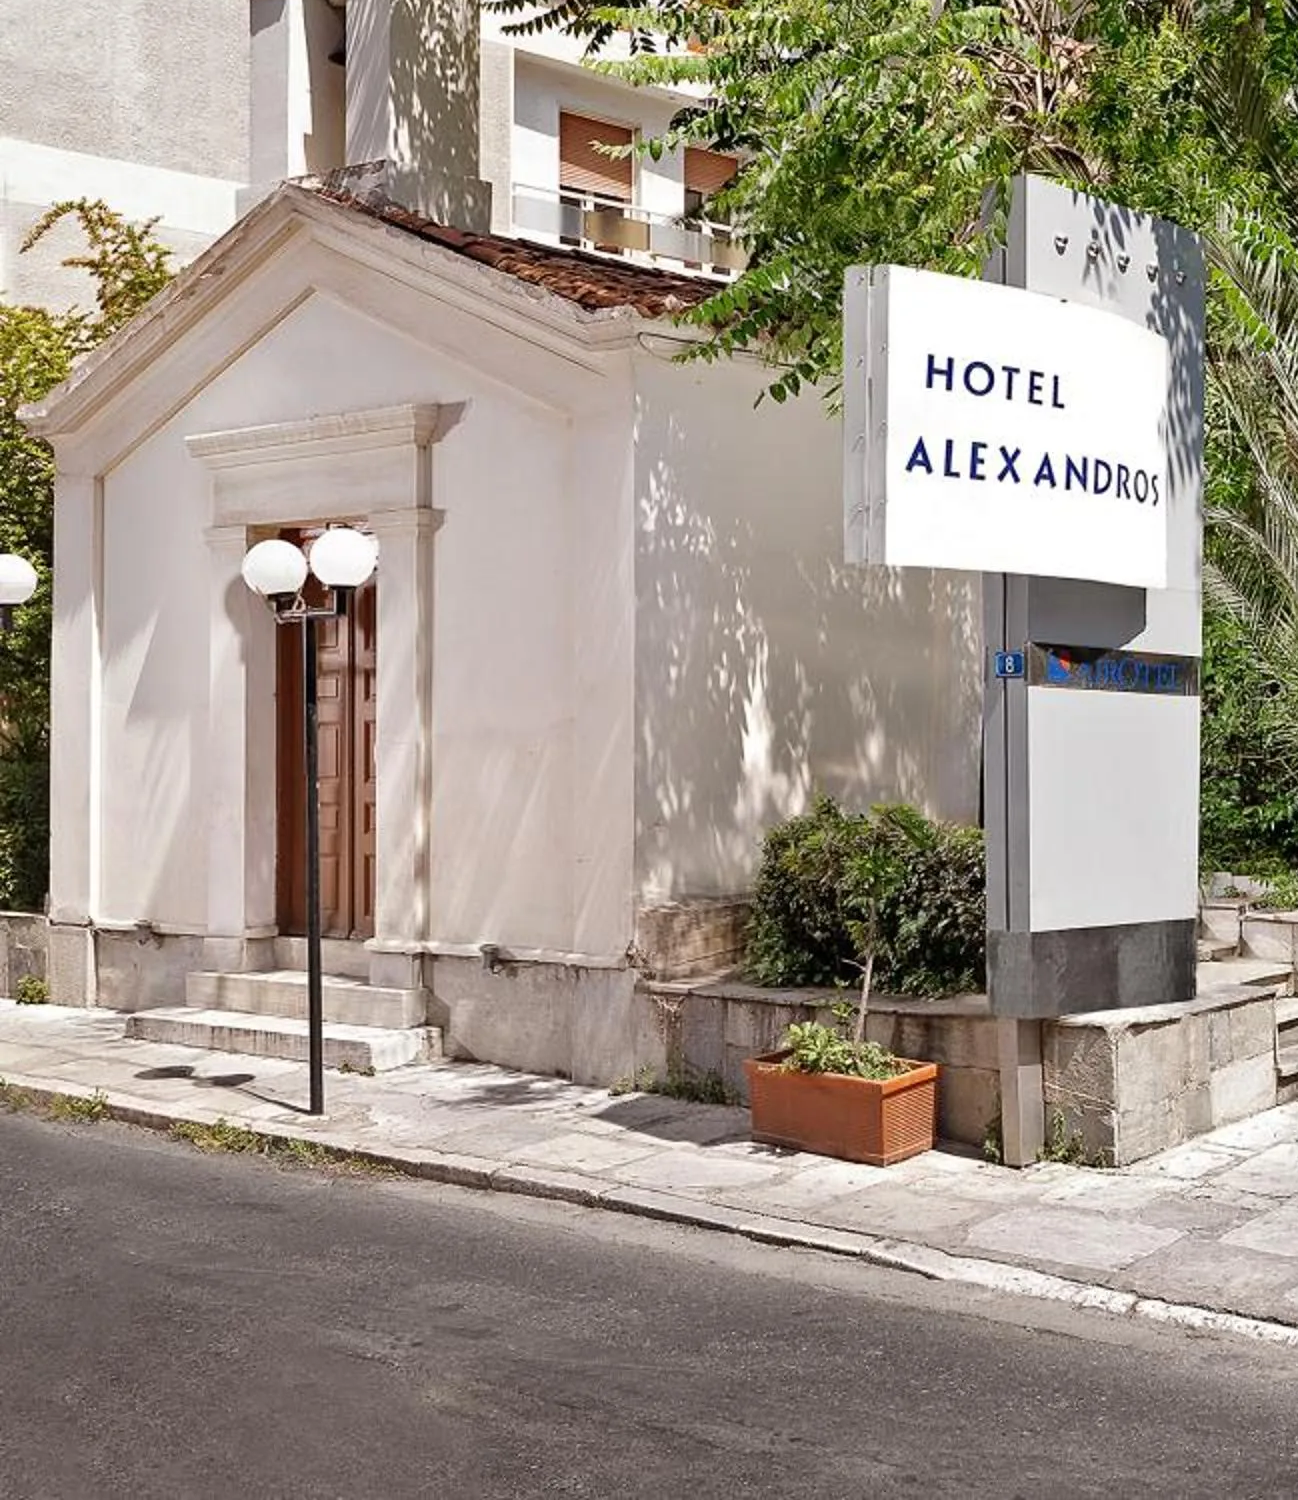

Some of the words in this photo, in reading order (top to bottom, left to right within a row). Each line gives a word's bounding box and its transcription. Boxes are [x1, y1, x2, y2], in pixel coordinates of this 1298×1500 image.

[925, 353, 1066, 409] HOTEL
[905, 435, 1160, 508] ALEXANDROS
[1004, 657, 1015, 674] 8
